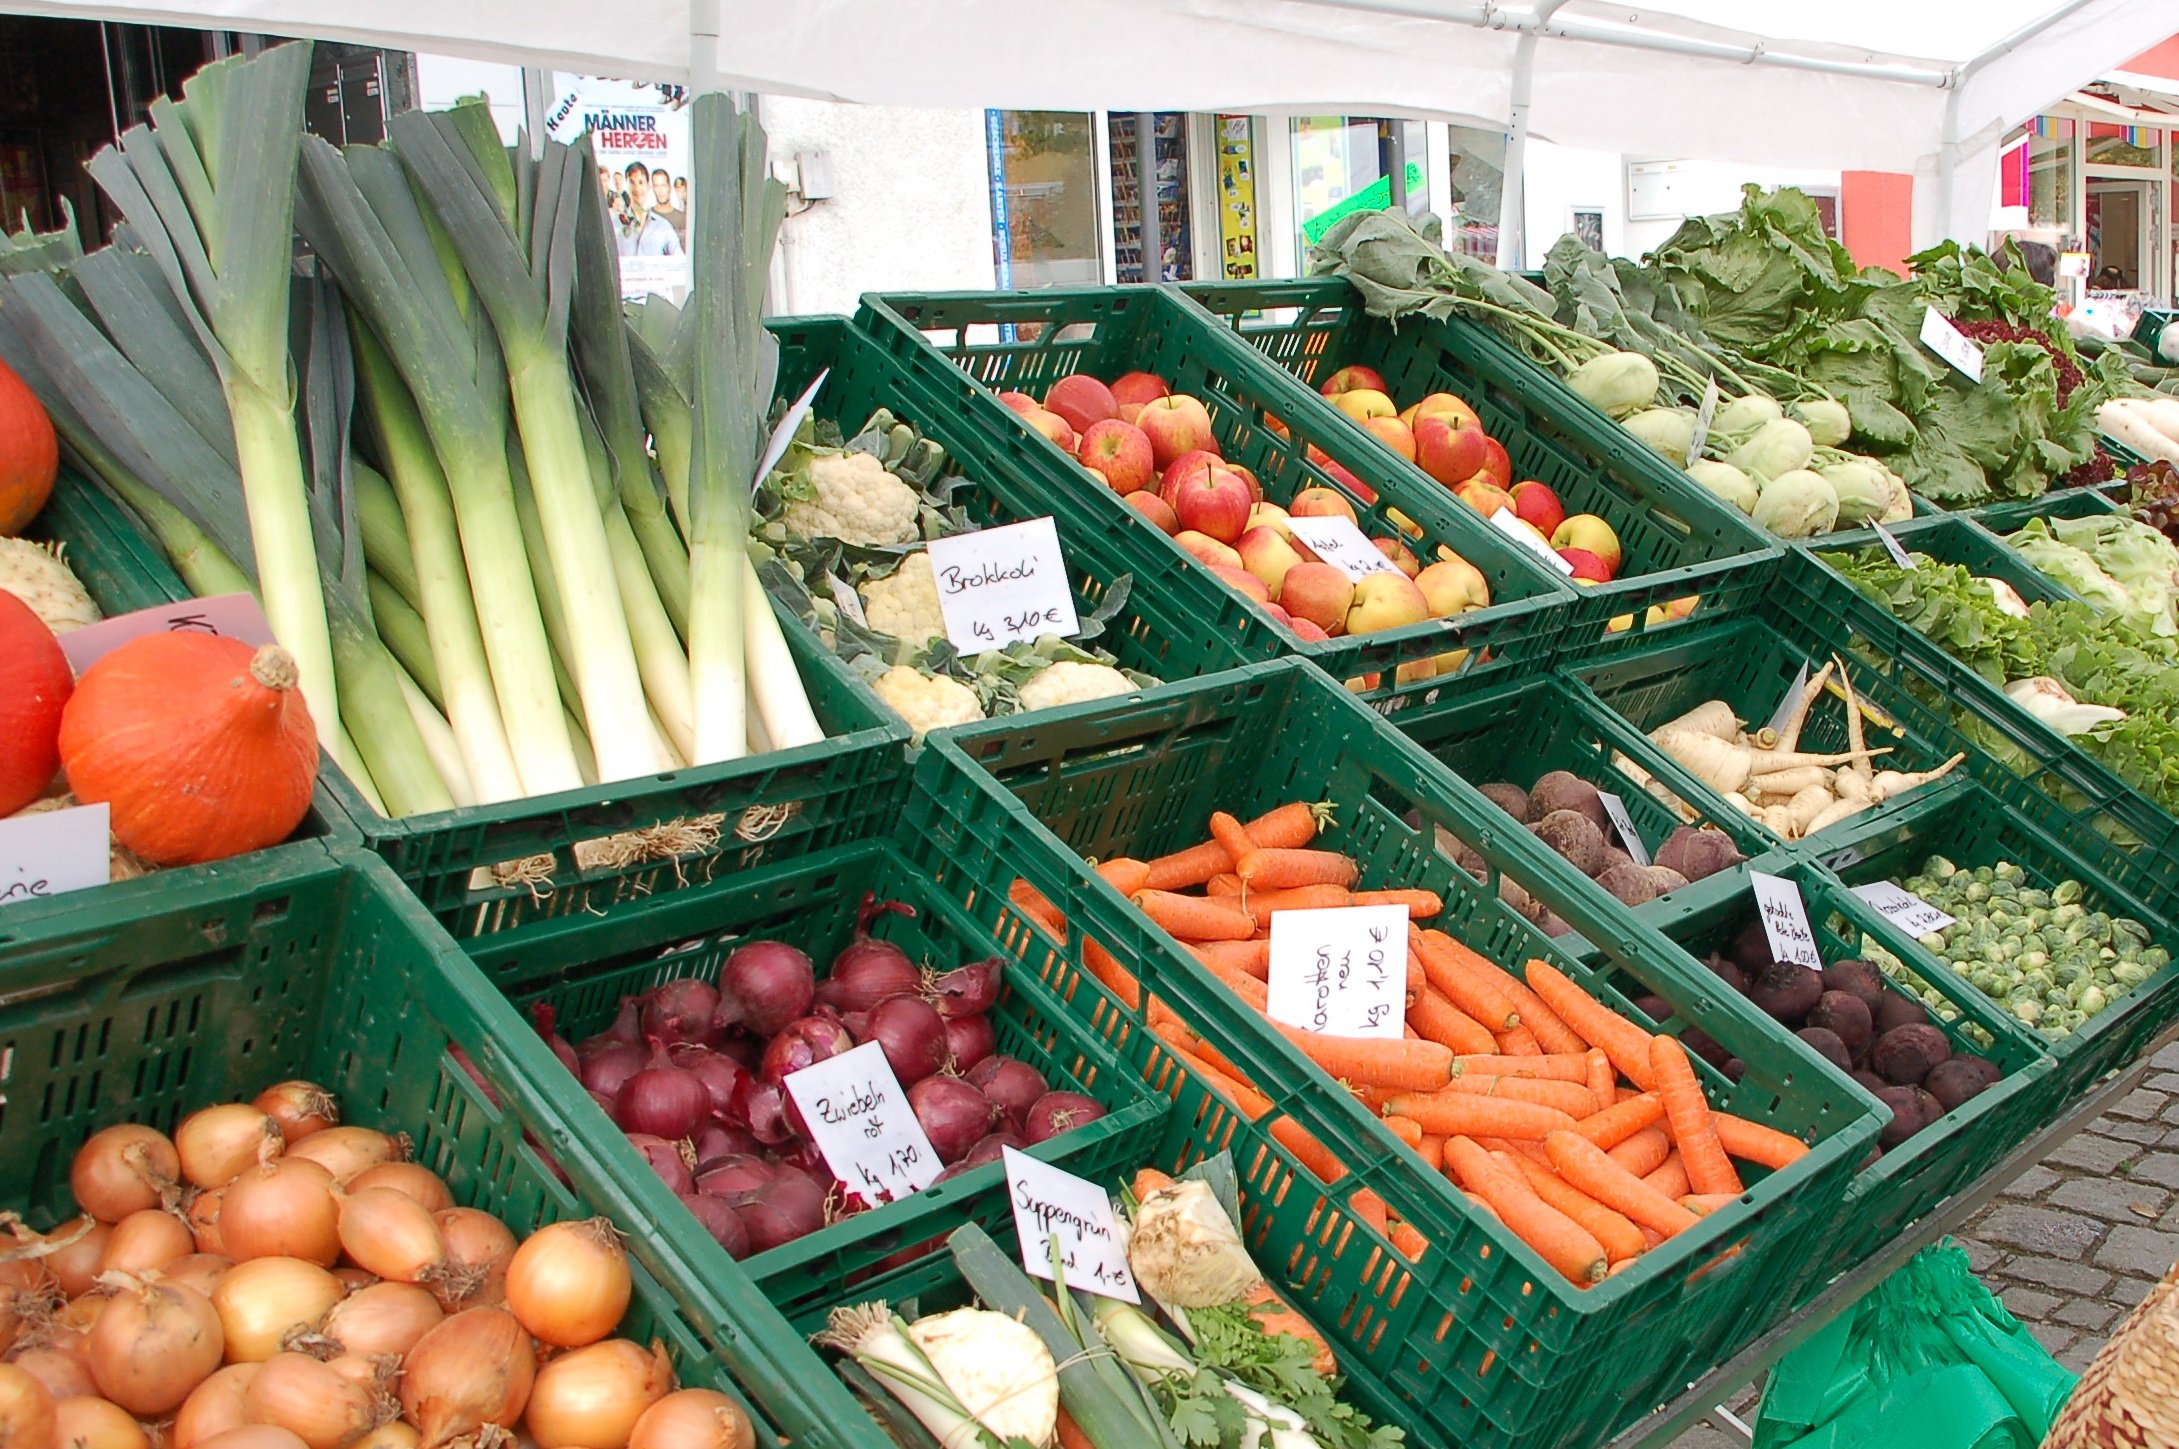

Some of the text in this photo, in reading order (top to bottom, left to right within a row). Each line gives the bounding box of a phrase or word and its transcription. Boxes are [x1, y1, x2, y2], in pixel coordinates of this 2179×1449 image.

[546, 93, 578, 132] Heute
[584, 109, 657, 132] MÄNNER
[601, 132, 668, 149] HERZEN
[995, 181, 1006, 224] KARTEN
[940, 555, 1038, 595] Brokkoli
[973, 621, 995, 641] kg
[1338, 949, 1351, 991] neu
[1358, 1003, 1390, 1029] kg
[815, 1081, 886, 1124] Zwiebeln
[863, 1115, 884, 1139] rot
[855, 1161, 886, 1190] kg
